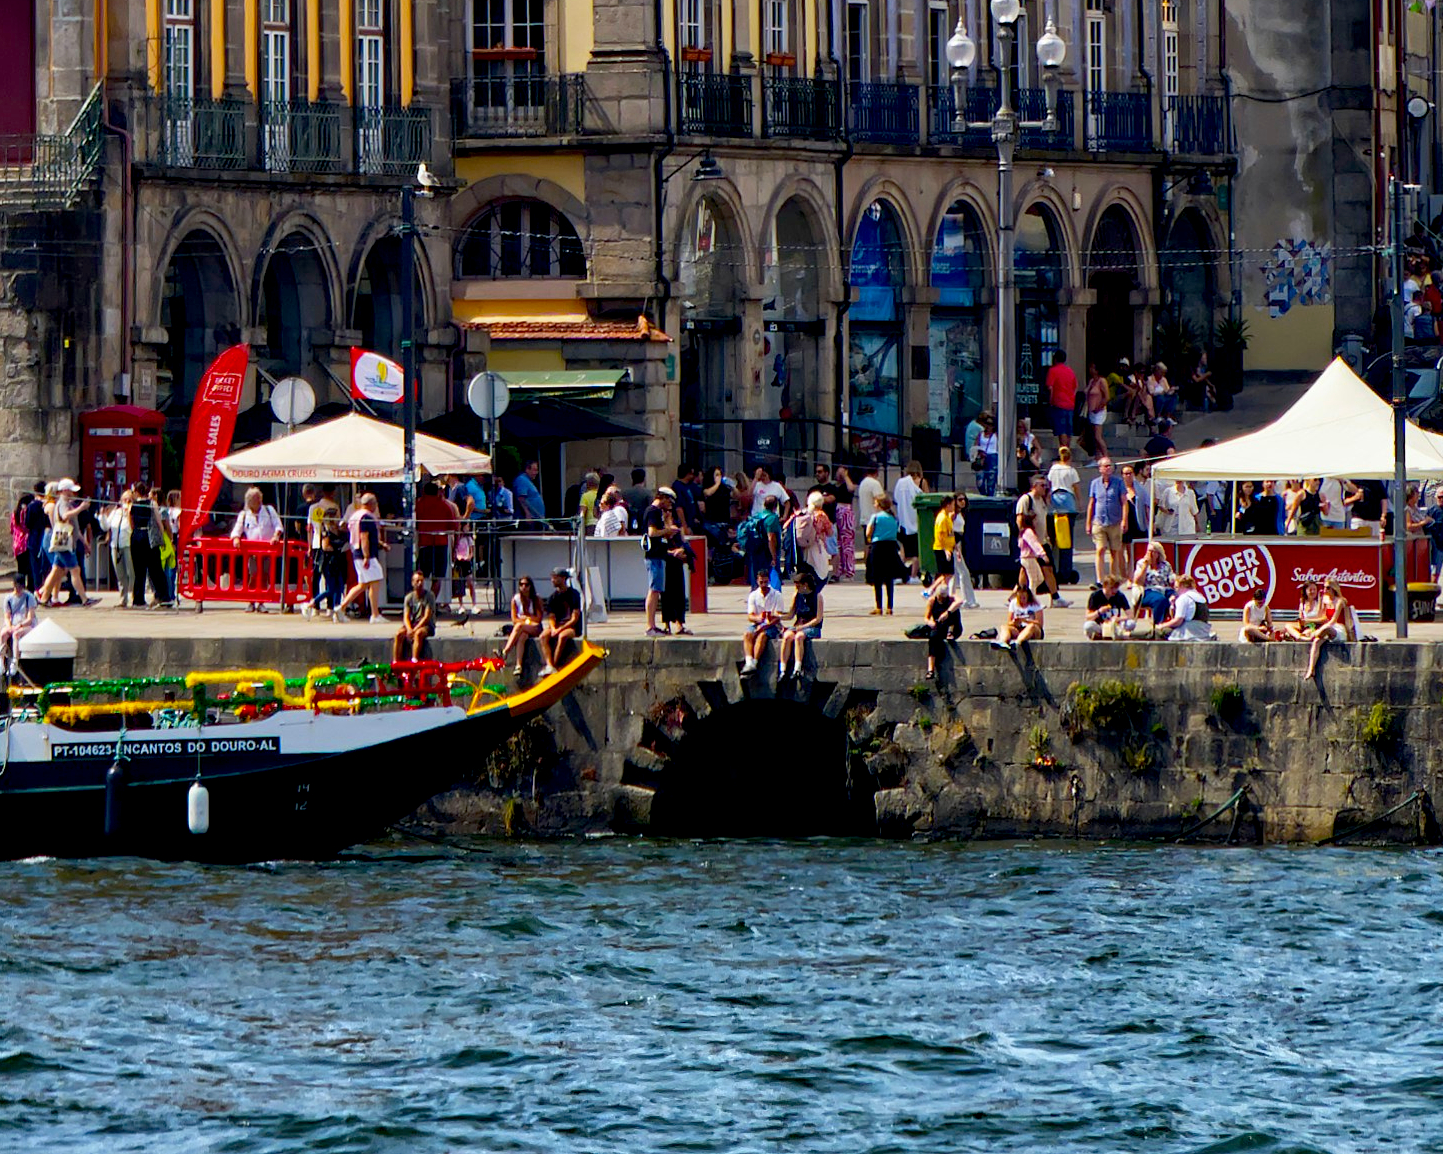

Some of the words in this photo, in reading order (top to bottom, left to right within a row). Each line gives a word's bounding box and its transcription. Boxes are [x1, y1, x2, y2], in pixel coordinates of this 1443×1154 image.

[201, 449, 216, 491] OFFICIAL
[209, 415, 221, 445] SALES
[232, 469, 260, 478] DOURO
[332, 469, 362, 478] TICKET
[1194, 548, 1260, 586] SUPER
[1291, 567, 1324, 582] Sabor
[1203, 567, 1264, 604] BOCK
[187, 741, 206, 753] DO
